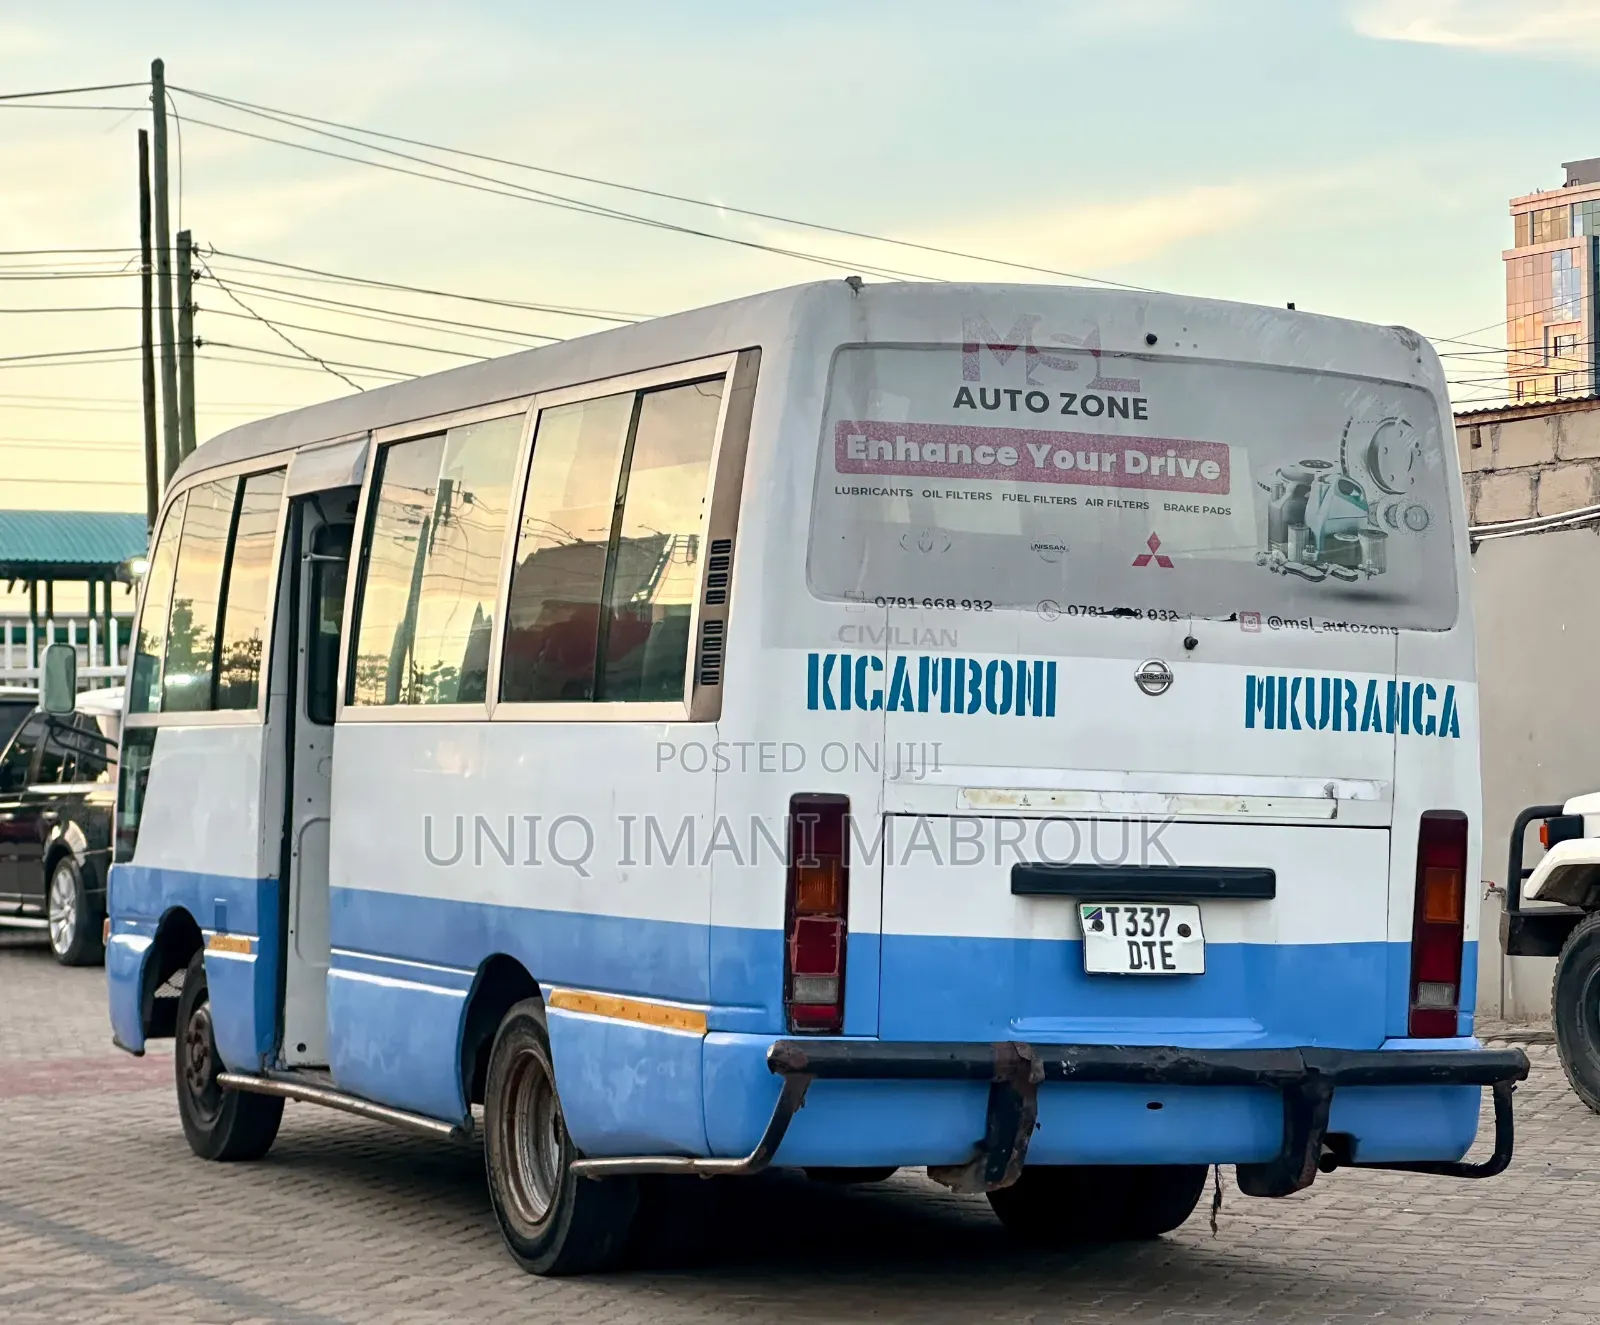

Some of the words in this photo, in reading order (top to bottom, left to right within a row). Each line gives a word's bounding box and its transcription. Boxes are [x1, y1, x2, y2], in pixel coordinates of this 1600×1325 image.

[952, 386, 1050, 414] AUTO
[1059, 392, 1149, 420] ZONE
[846, 434, 1019, 467] Enhance
[1026, 442, 1117, 473] Your
[1124, 449, 1222, 481] Drive
[834, 486, 914, 498] LUBRICANTS
[922, 489, 943, 499] OIL
[945, 490, 993, 501] FILTERS
[1002, 493, 1031, 503] FUEL
[1033, 495, 1078, 506] FILTERS
[1085, 498, 1104, 507] AIR
[1107, 499, 1150, 510] FILTERS
[1163, 503, 1200, 514] BRAKE
[1202, 506, 1232, 516] PADS
[1034, 543, 1066, 551] NISSAN
[874, 596, 918, 610] 0781
[922, 598, 957, 611] 668
[960, 599, 993, 612] 932
[1067, 604, 1108, 619] 0781
[838, 624, 958, 647] CIVILIAN
[806, 653, 1058, 717] KIGAMBONI
[1245, 674, 1461, 739] MKURANGA
[1105, 906, 1119, 936] T
[1124, 907, 1170, 937] 337
